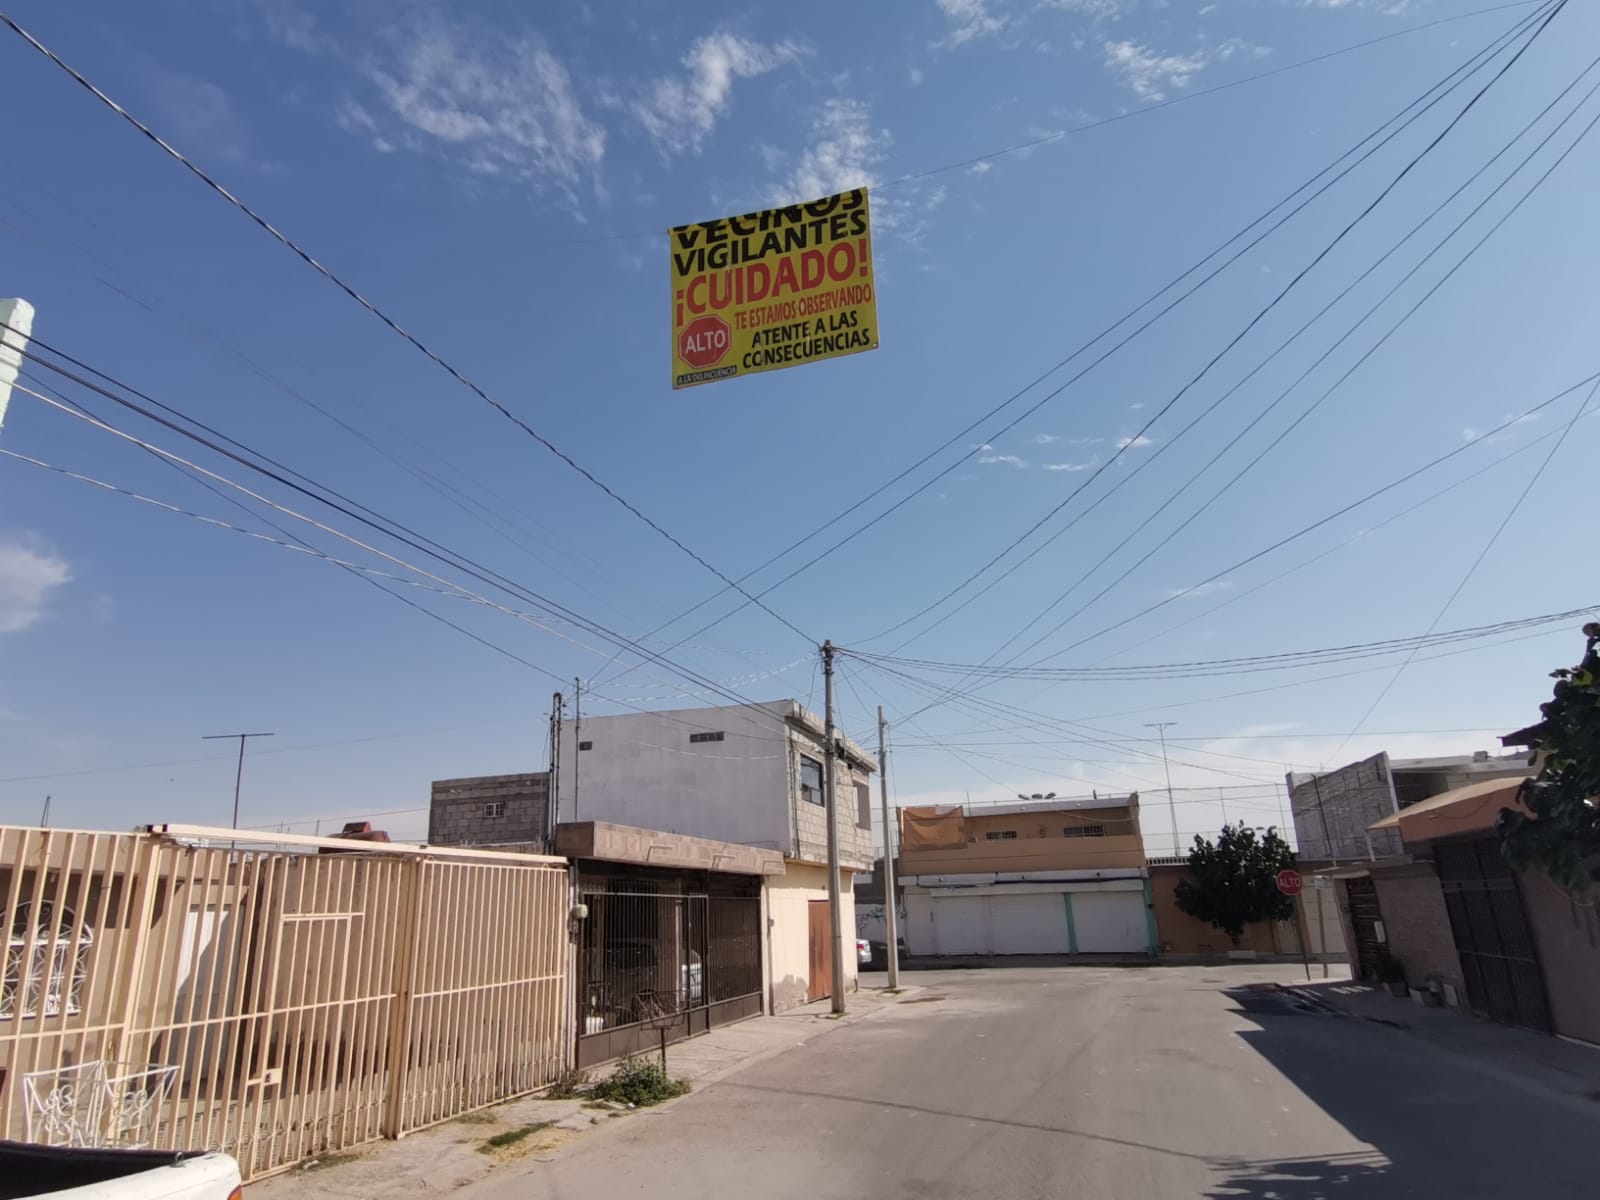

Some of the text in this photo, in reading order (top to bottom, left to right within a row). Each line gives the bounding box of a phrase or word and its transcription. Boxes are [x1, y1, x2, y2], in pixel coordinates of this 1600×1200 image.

[673, 209, 867, 277] VIGILANTES
[676, 238, 868, 328] ¡CUIDADO!
[735, 283, 872, 330] TE ESTAMOS OBSERVANDO
[685, 329, 726, 354] ALTO
[743, 328, 870, 369] CONSECUENCIAS
[751, 310, 858, 348] ATENTE A LAS
[692, 366, 737, 381] DELINCUENCIA
[1279, 877, 1301, 888] ALTO
